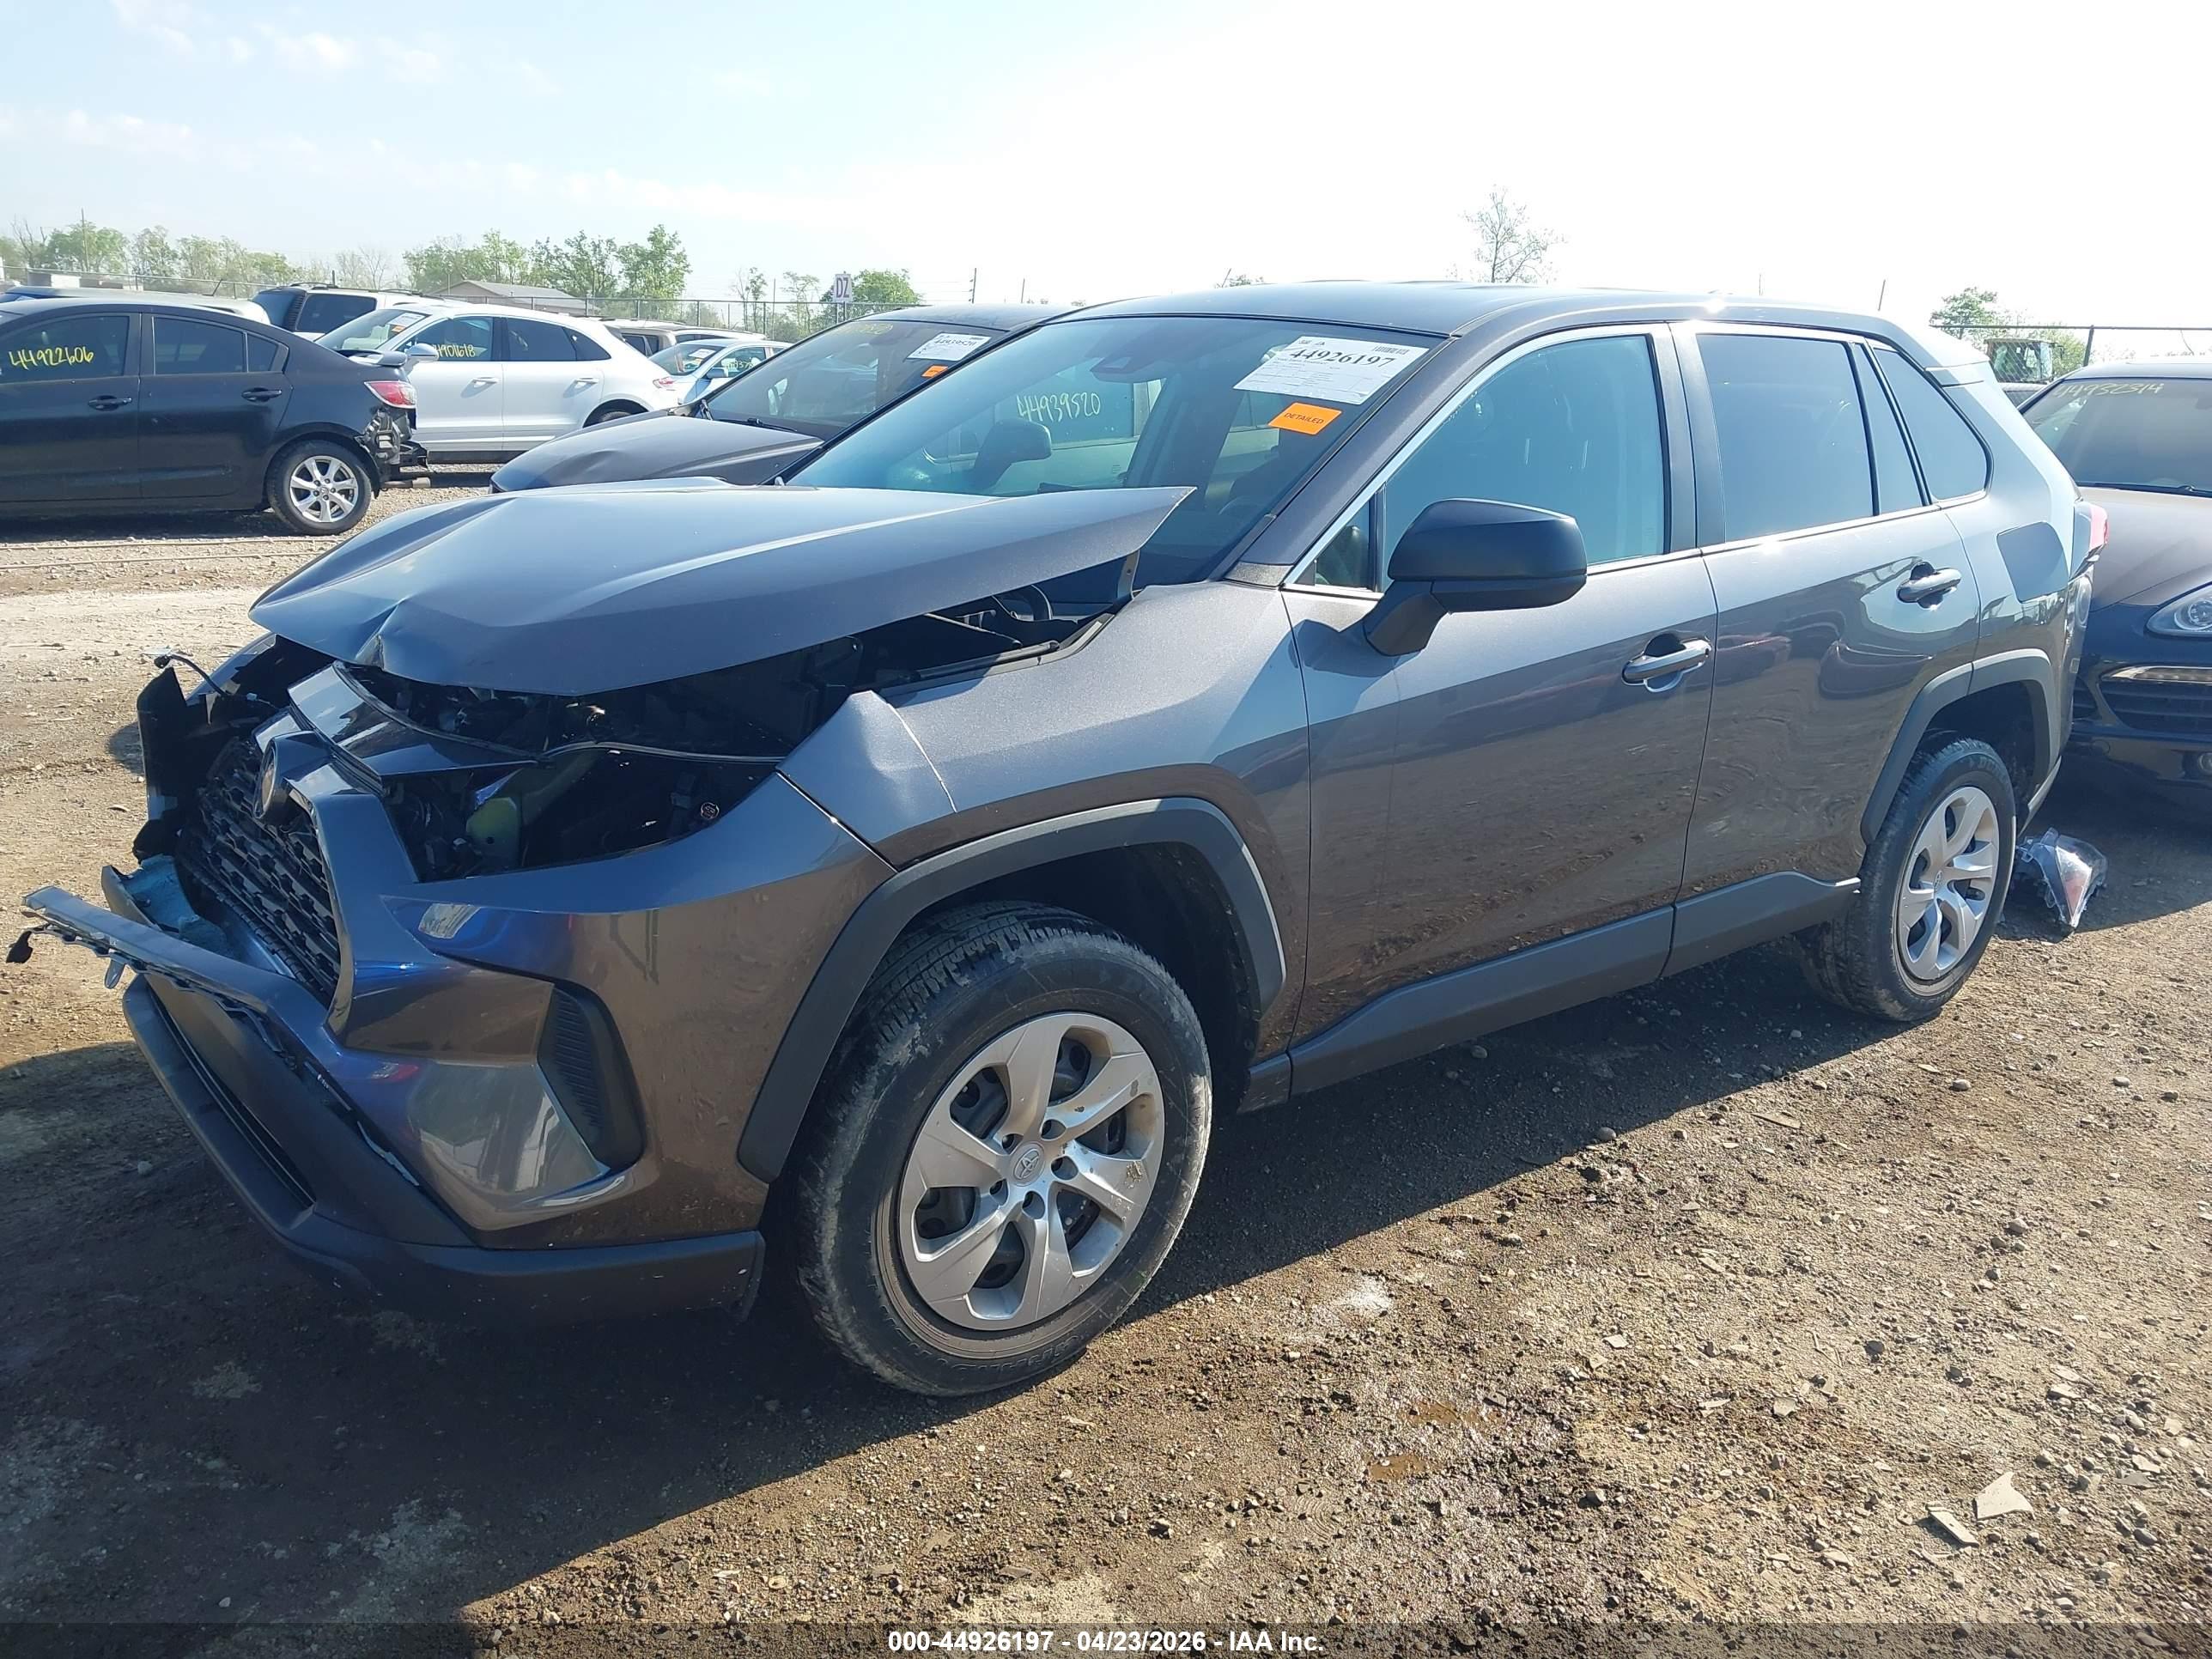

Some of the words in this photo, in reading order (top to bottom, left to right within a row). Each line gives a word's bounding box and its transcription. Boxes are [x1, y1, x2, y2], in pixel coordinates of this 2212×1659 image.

[836, 276, 850, 298] DZ
[9, 346, 94, 370] 44922606
[1289, 349, 1397, 368] 44926197
[1016, 392, 1101, 422] 44939520
[1284, 411, 1325, 426] DETAILED
